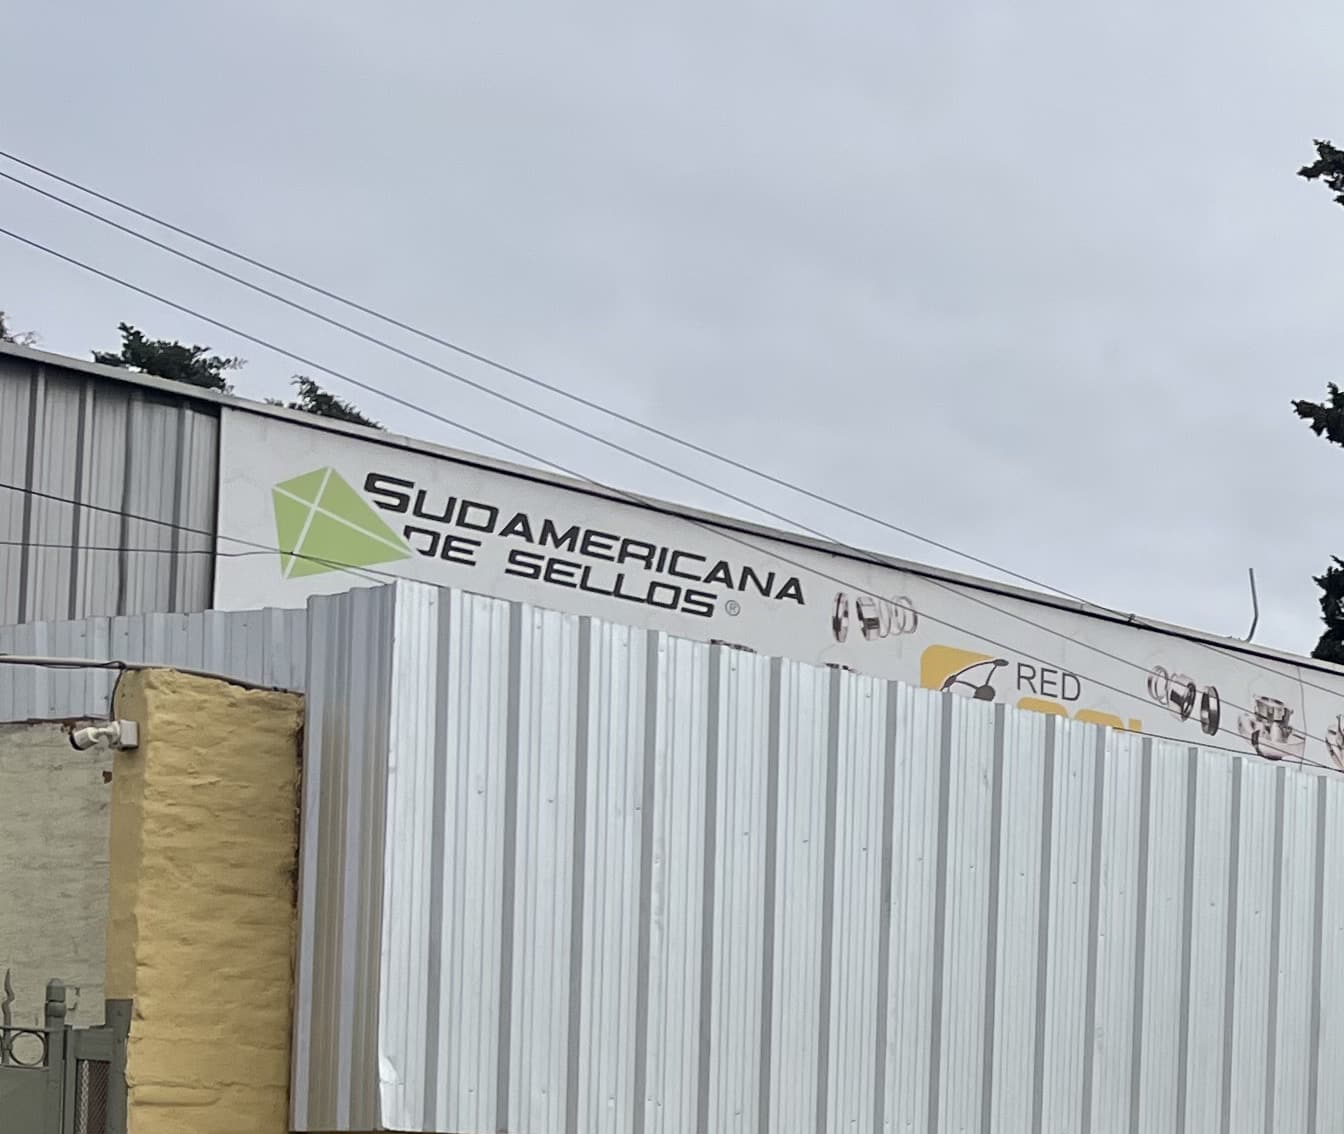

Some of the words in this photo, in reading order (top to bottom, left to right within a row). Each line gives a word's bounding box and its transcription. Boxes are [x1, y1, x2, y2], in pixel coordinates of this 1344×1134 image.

[364, 472, 805, 605] SUDAMERICANA
[403, 526, 477, 566] DE
[505, 551, 717, 617] SELLOS
[1016, 662, 1081, 702] RED
